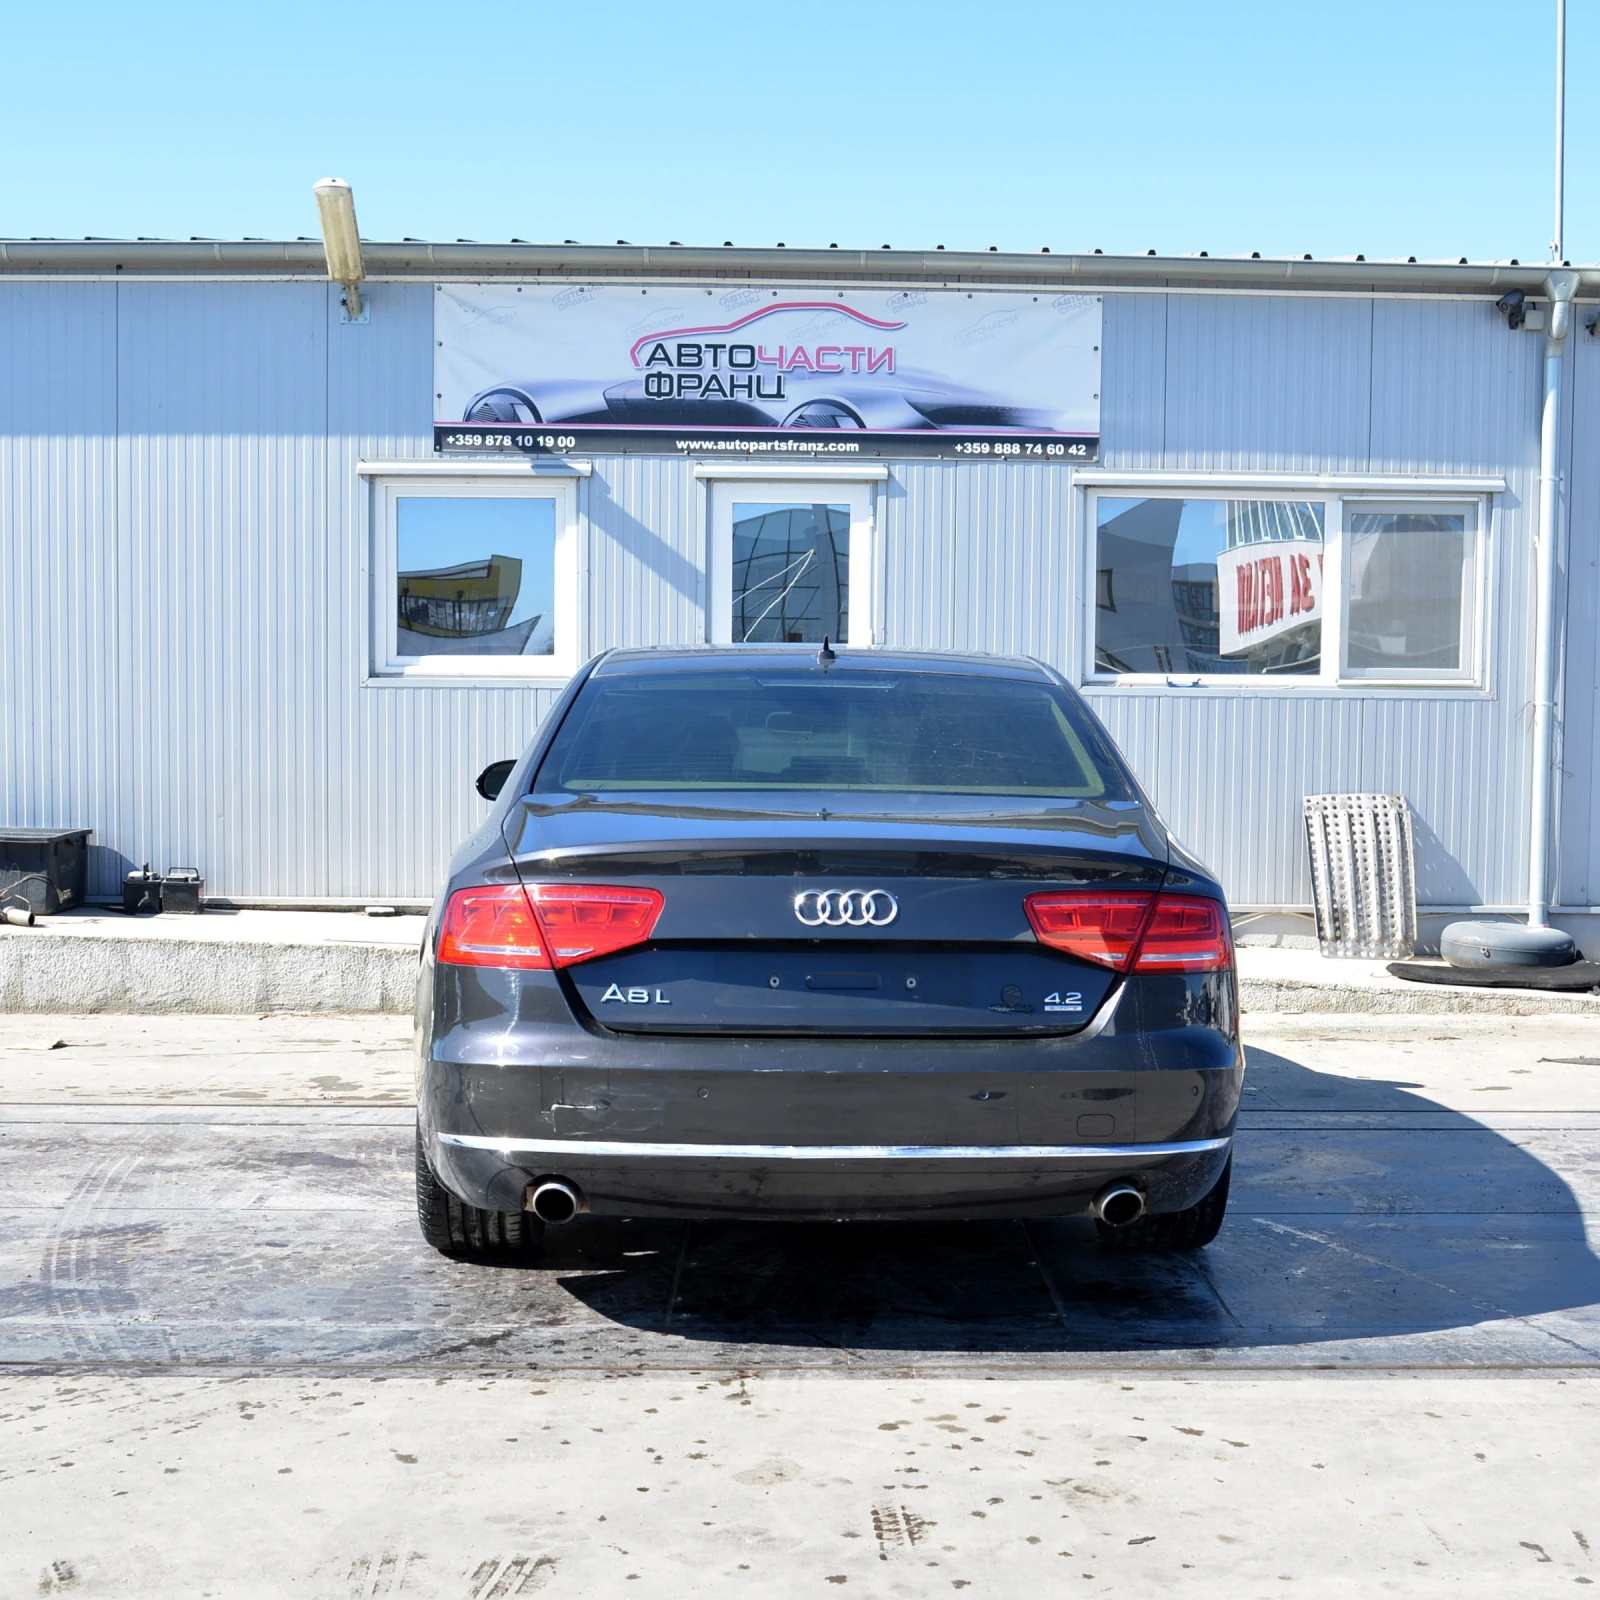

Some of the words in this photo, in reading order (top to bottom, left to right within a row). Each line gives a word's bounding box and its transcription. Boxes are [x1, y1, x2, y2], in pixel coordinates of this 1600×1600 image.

[645, 343, 894, 371] АВТОЧАСТИ
[644, 371, 785, 399] ФРАНЦ
[446, 434, 482, 446] +359
[485, 435, 512, 446] 878
[516, 435, 533, 447] 10
[537, 435, 554, 447] 19
[557, 436, 576, 447] 00
[675, 439, 860, 452] www.autopartsfranz.com
[954, 442, 990, 453] +359
[994, 443, 1020, 454] 888
[1025, 443, 1043, 455] 74
[1046, 444, 1064, 455] 60
[1068, 444, 1086, 455] 42
[600, 982, 649, 1004] A8
[655, 989, 670, 1004] L
[1043, 991, 1082, 1004] 4.2
